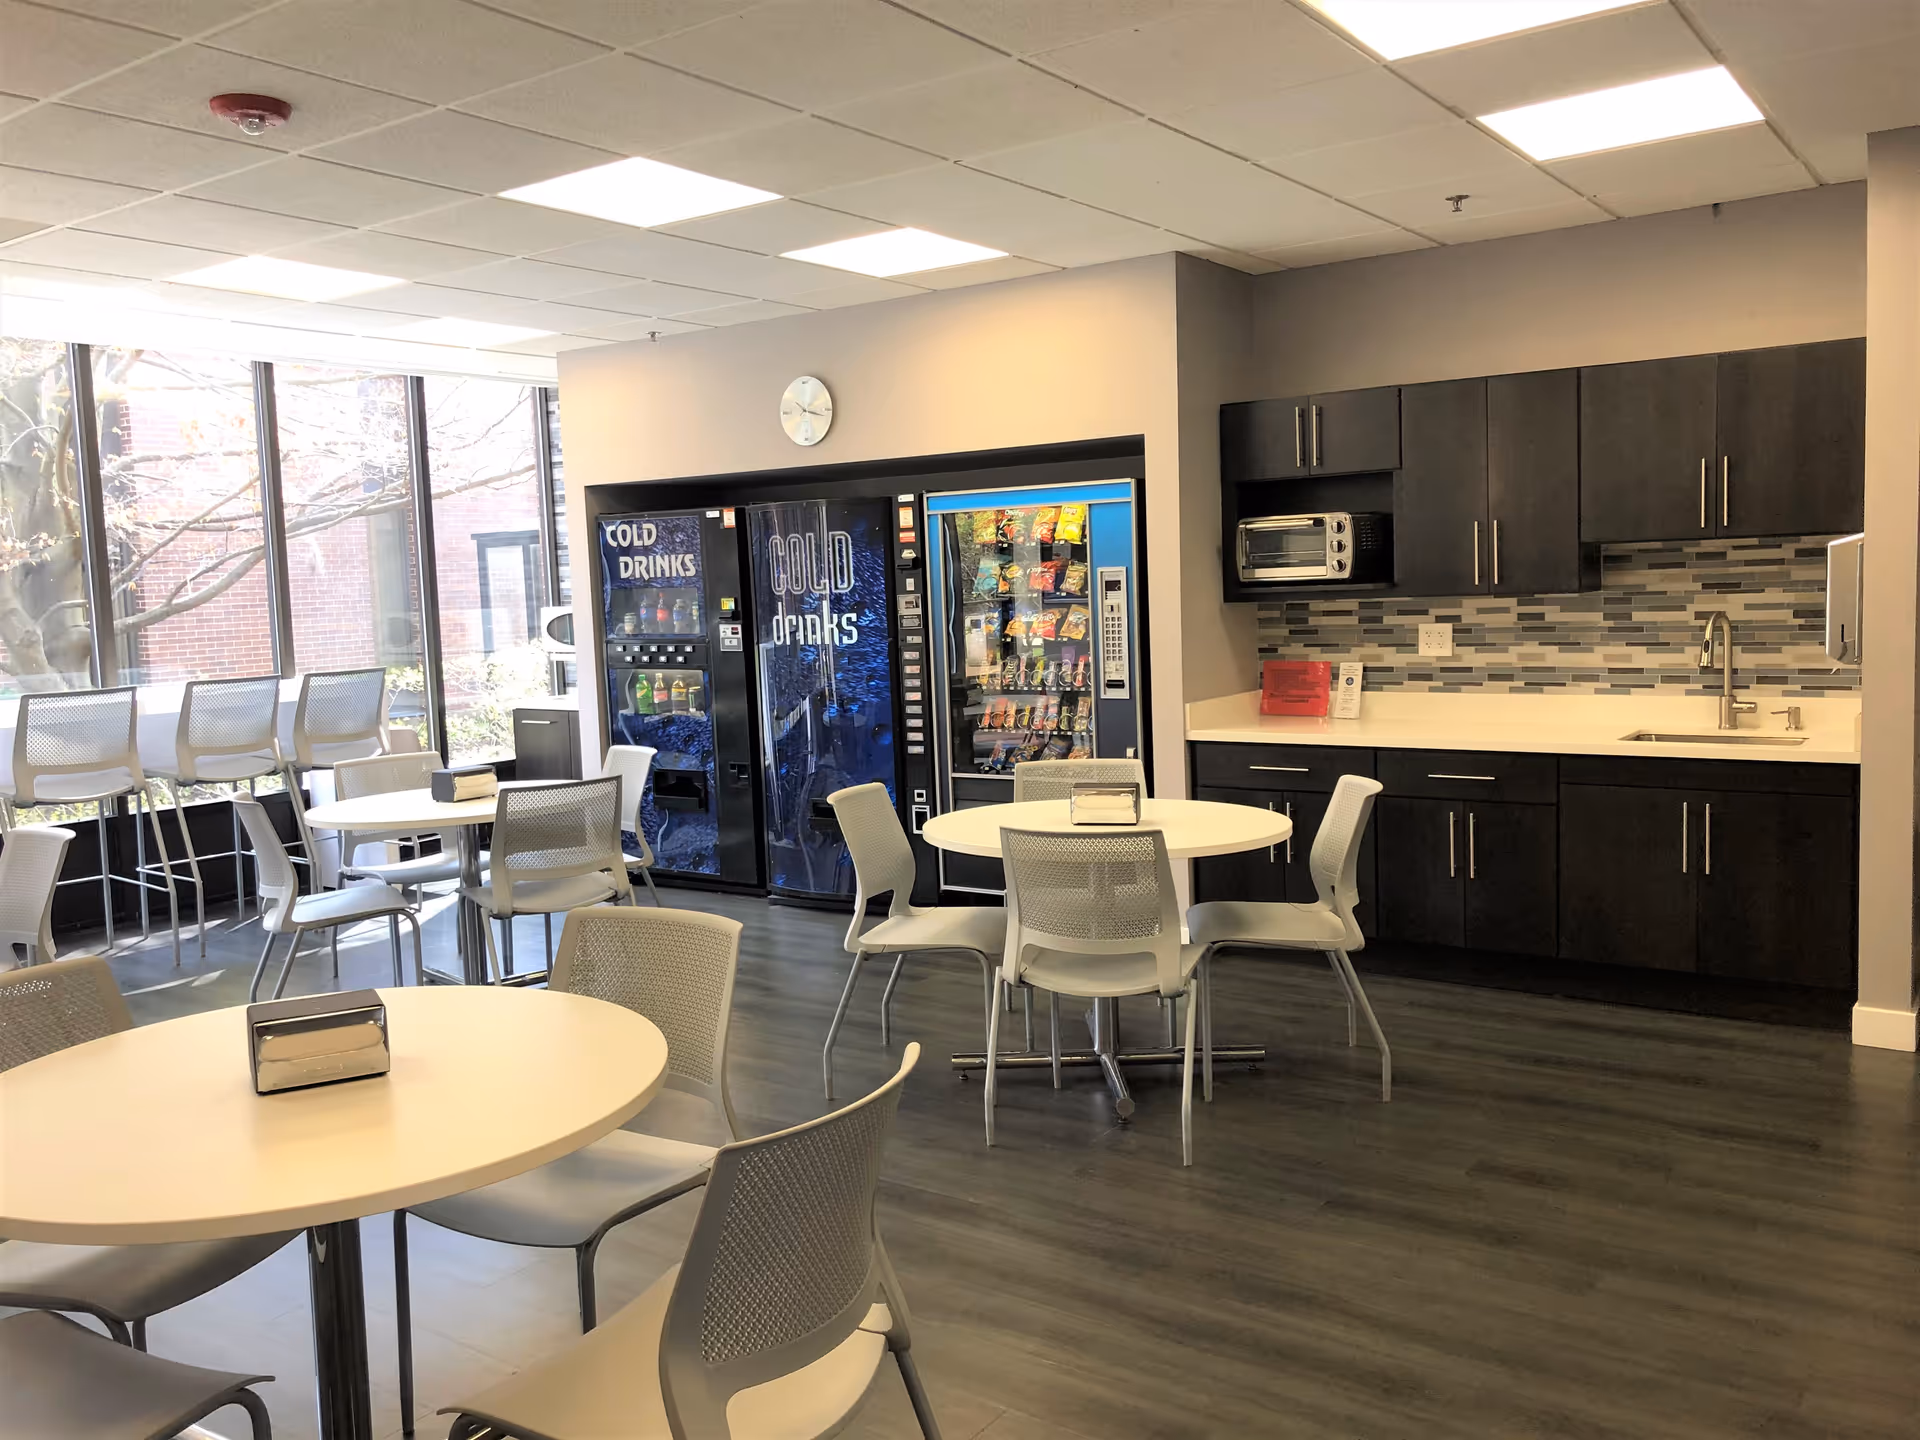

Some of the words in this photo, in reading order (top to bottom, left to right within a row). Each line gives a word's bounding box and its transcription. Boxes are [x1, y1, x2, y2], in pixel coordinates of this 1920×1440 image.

[606, 523, 657, 547] COLD
[619, 554, 696, 580] DRINKS
[769, 531, 855, 595] COLD
[773, 600, 858, 646] drinks
